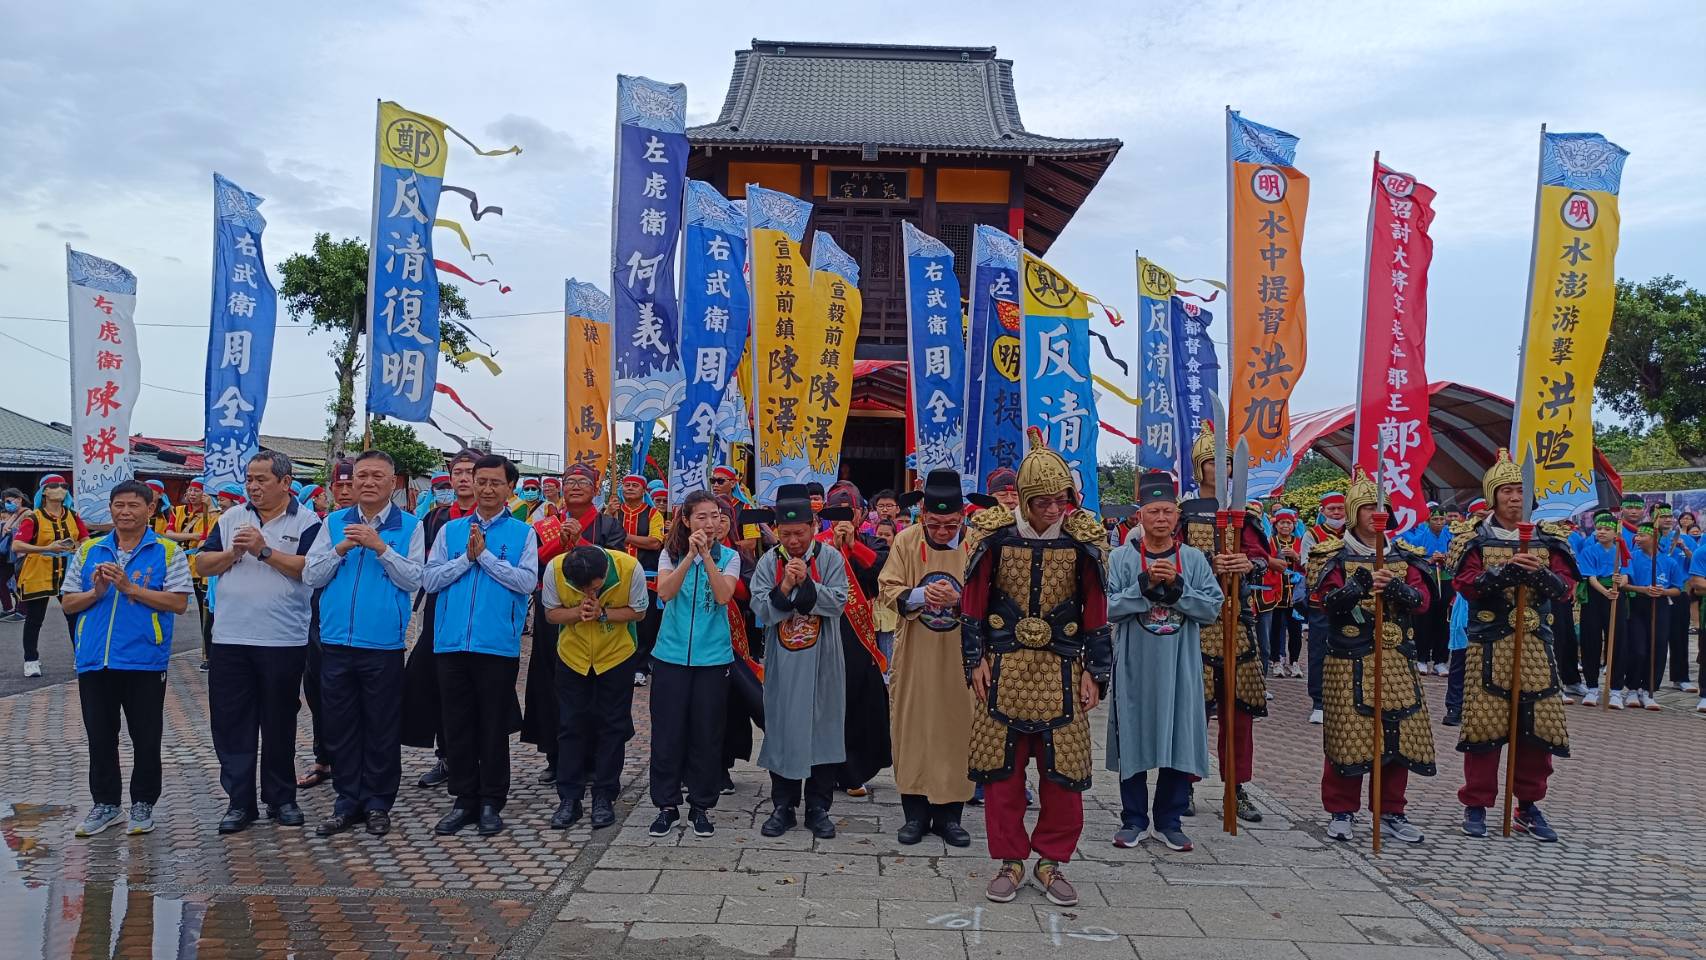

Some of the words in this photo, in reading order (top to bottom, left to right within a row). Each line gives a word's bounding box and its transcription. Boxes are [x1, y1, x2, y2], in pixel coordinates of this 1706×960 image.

[393, 124, 431, 165] 鄭
[1258, 173, 1281, 198] 明
[1568, 197, 1591, 225] 明
[380, 176, 435, 402] 反清復明
[627, 135, 671, 353] 左虎衛何義
[1147, 266, 1169, 294] 鄭
[767, 238, 804, 437] 宣毅前鎮陳澤
[804, 280, 848, 460] 宣毅前鎮陳澤
[1033, 323, 1096, 518] 反清
[1146, 302, 1174, 460] 反清復明
